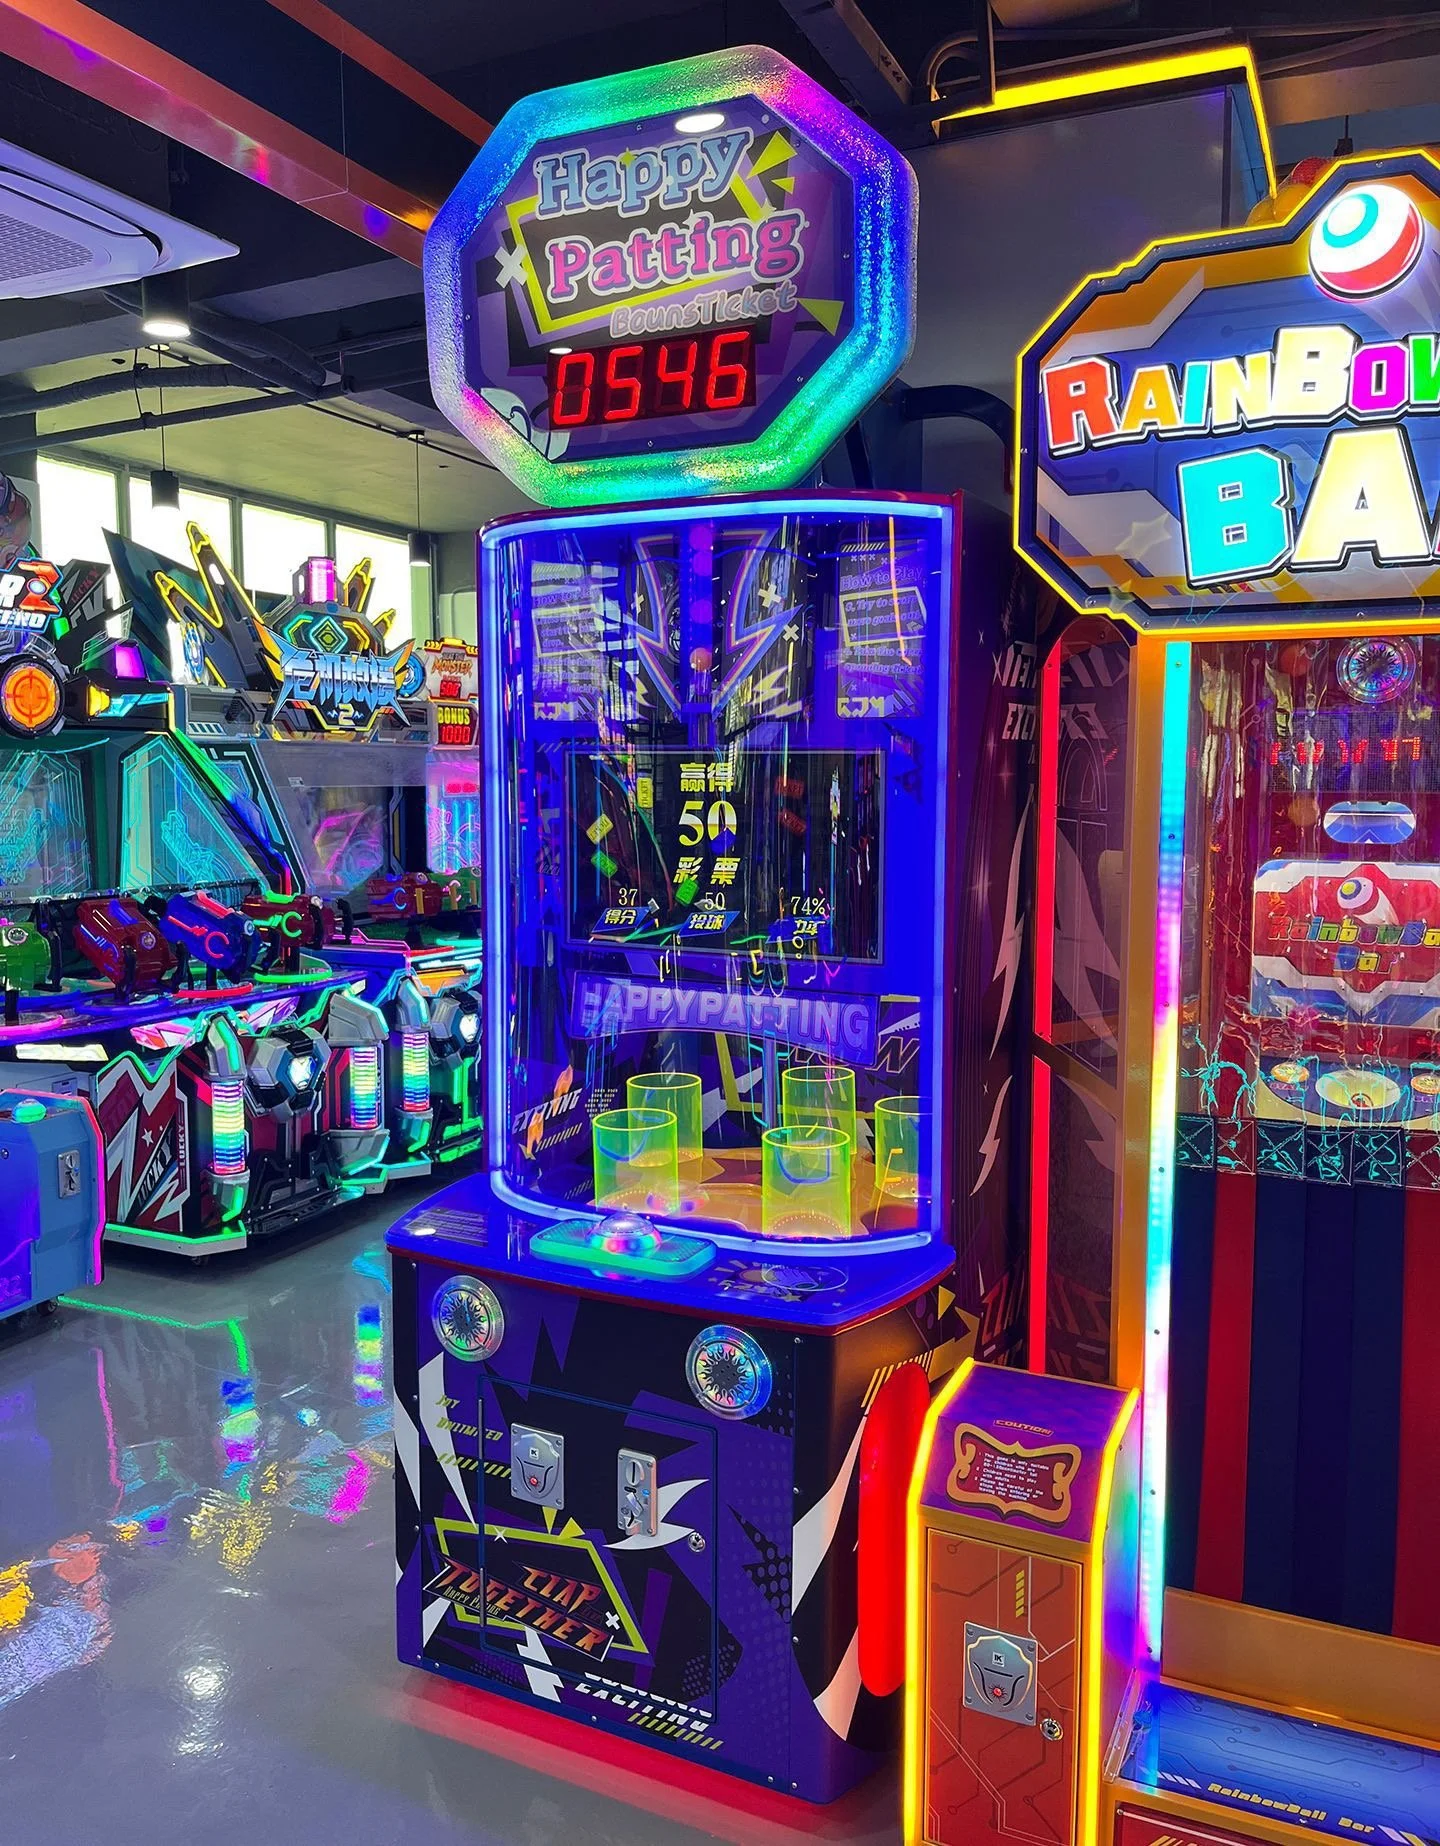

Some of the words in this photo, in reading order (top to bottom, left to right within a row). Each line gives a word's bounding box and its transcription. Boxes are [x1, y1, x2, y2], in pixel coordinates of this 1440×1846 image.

[535, 127, 753, 217] Happy
[545, 210, 804, 303] Patting
[552, 331, 750, 426] 0546
[1178, 425, 1440, 588] BA
[840, 575, 872, 592] How
[875, 571, 890, 584] to
[894, 566, 924, 582] Play
[438, 706, 470, 725] BONUS
[679, 762, 735, 793] 赢得
[678, 800, 737, 848] 50
[618, 887, 638, 906] 37
[704, 892, 726, 911] 50
[790, 896, 827, 916] 74%
[604, 909, 638, 925] 得分
[689, 913, 725, 930] 投球
[435, 1555, 609, 1652] TOGETHER
[522, 1565, 602, 1614] CLAP
